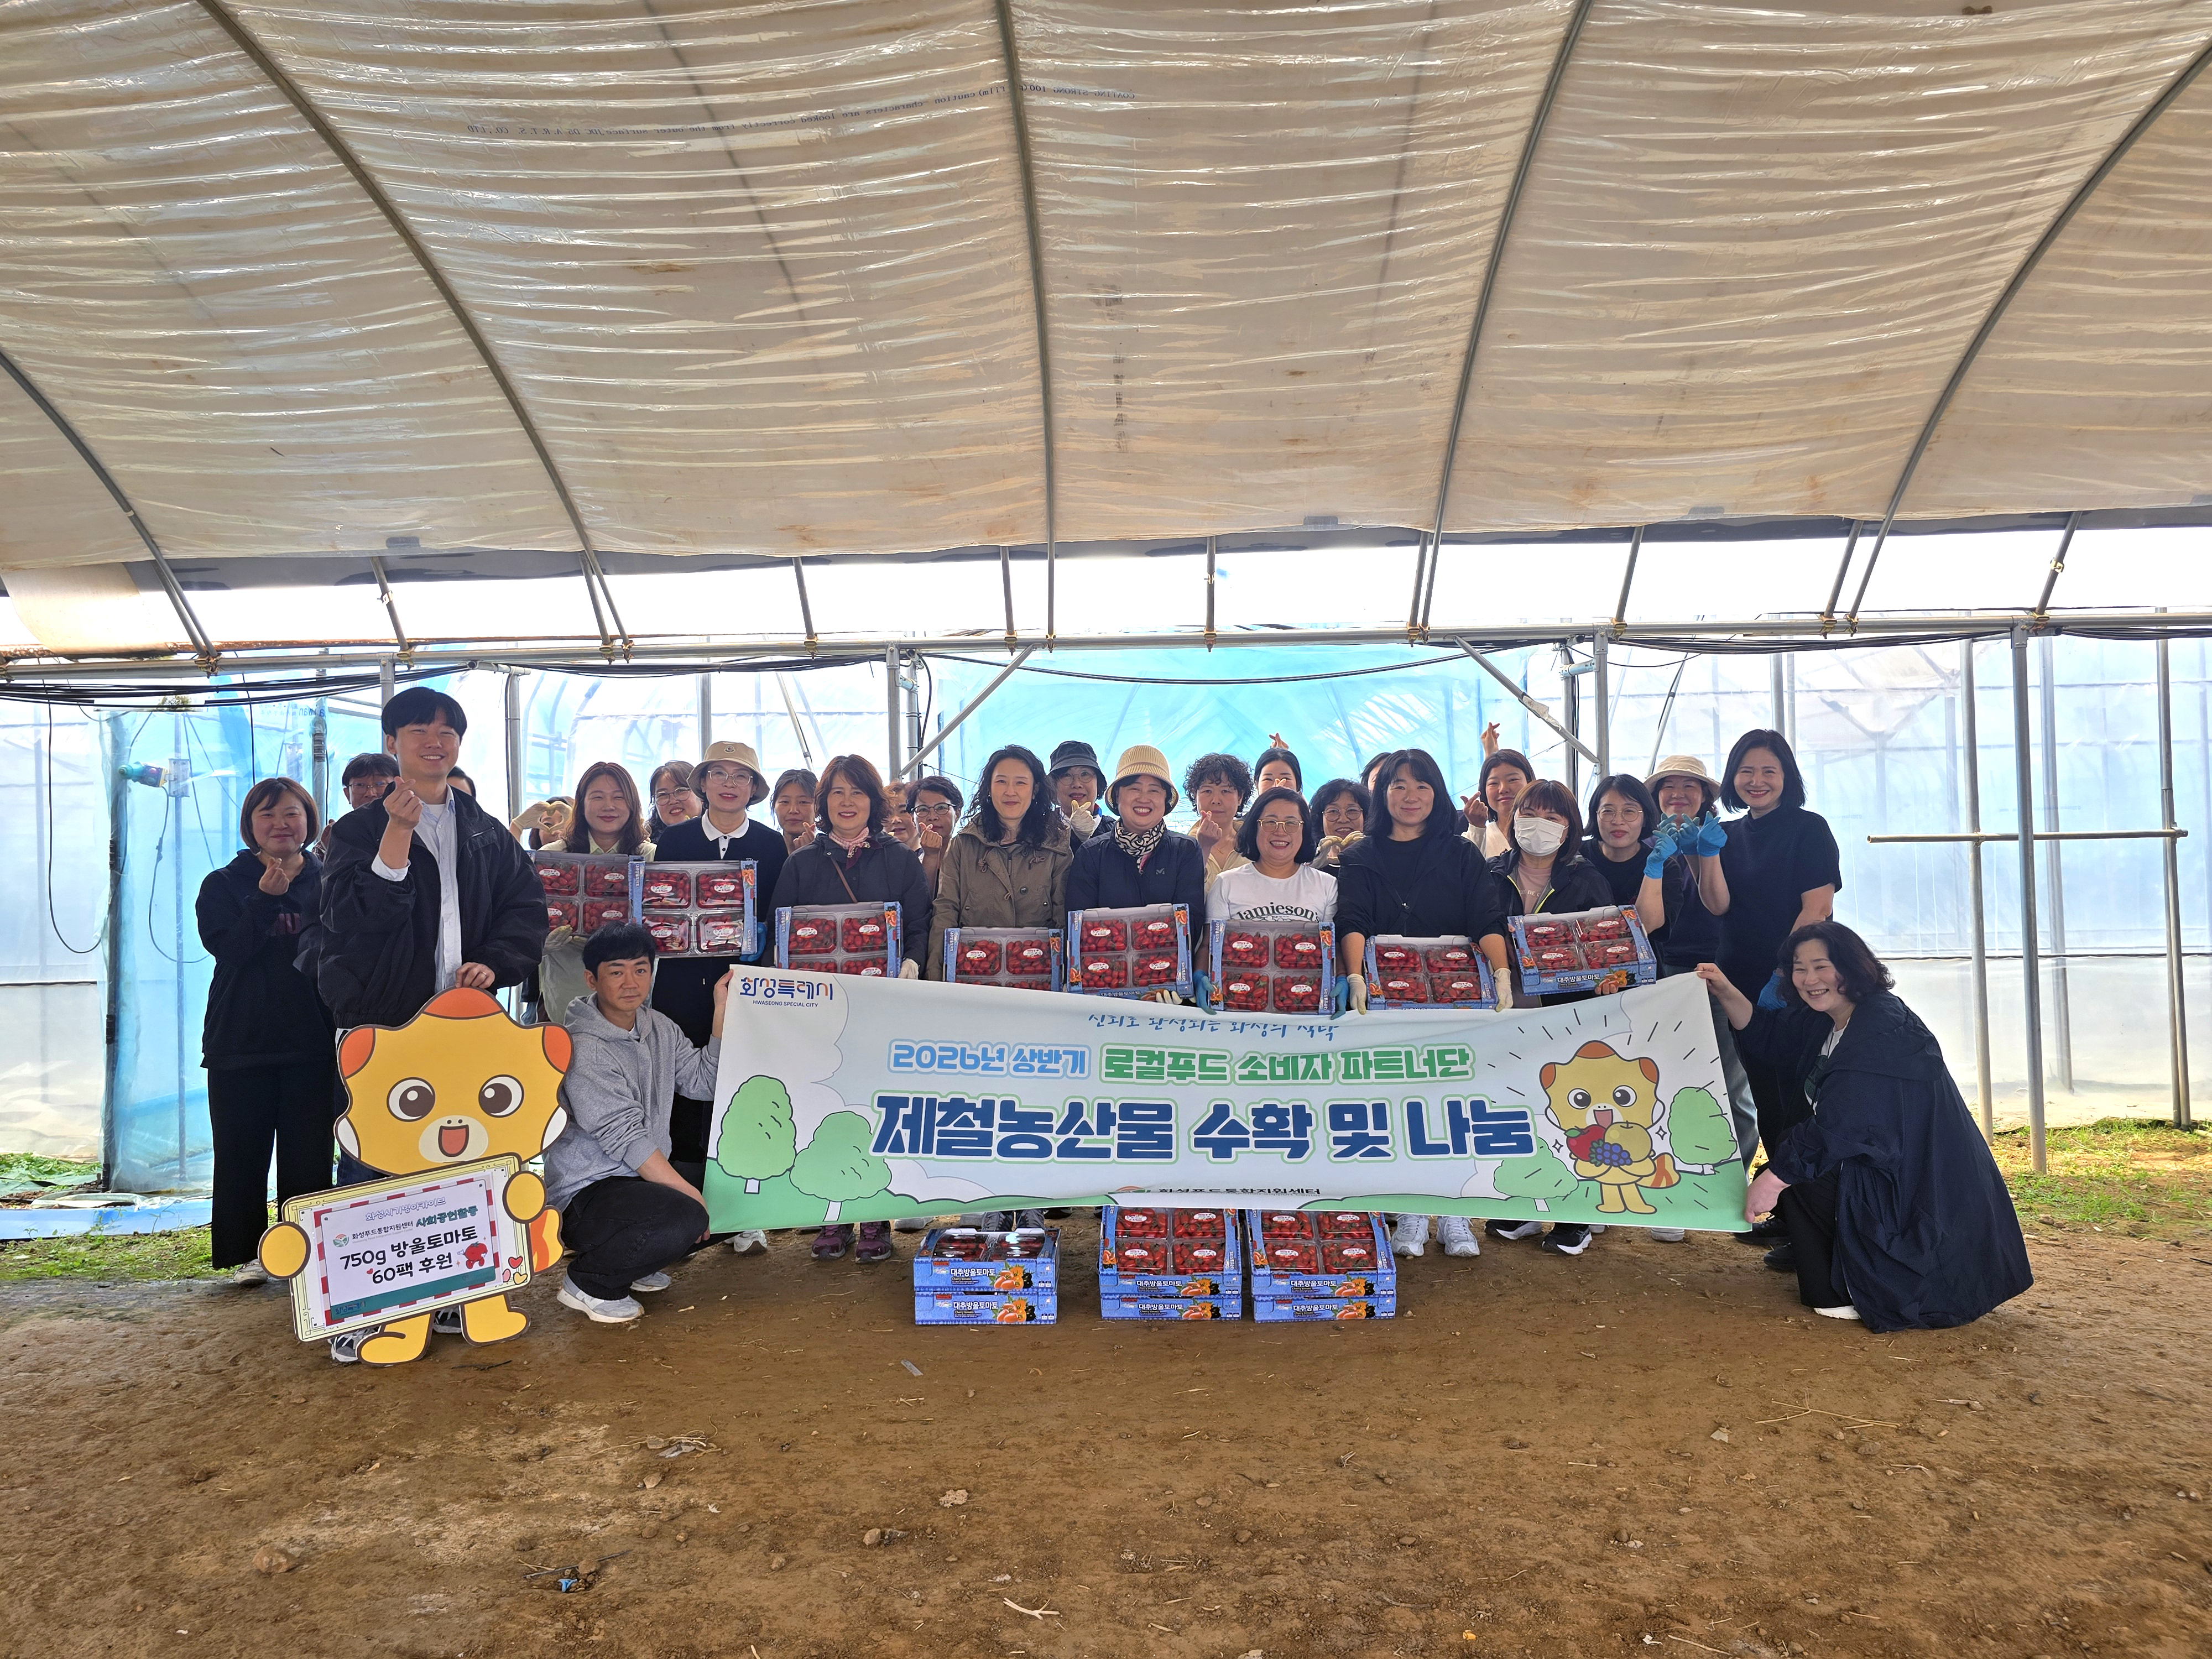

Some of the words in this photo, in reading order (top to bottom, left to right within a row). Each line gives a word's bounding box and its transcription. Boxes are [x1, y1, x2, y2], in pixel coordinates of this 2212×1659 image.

[739, 977, 833, 1000] 화성특례시
[1556, 973, 1601, 983] 대추방울토마토
[893, 1044, 1005, 1073] 2026년
[1013, 1045, 1086, 1076] 상반기
[1104, 1047, 1228, 1081] 로컬푸드
[1237, 1050, 1333, 1081] 소비자
[1341, 1046, 1471, 1079] 파트너단
[871, 1095, 1174, 1160] 제철농산물
[1193, 1102, 1313, 1159] 수확
[1329, 1102, 1392, 1158] 및
[1403, 1098, 1533, 1156] 나눔
[352, 1220, 414, 1240] 화성푸드통합지원센터
[415, 1205, 478, 1228] 사회공헌활동
[340, 1249, 387, 1270] 750g
[390, 1225, 478, 1259] 방울토마토
[372, 1261, 414, 1284] 60팩
[418, 1251, 453, 1274] 후원
[950, 1268, 996, 1277] 대추방울토마토
[953, 1301, 999, 1310] 대추방울토마토
